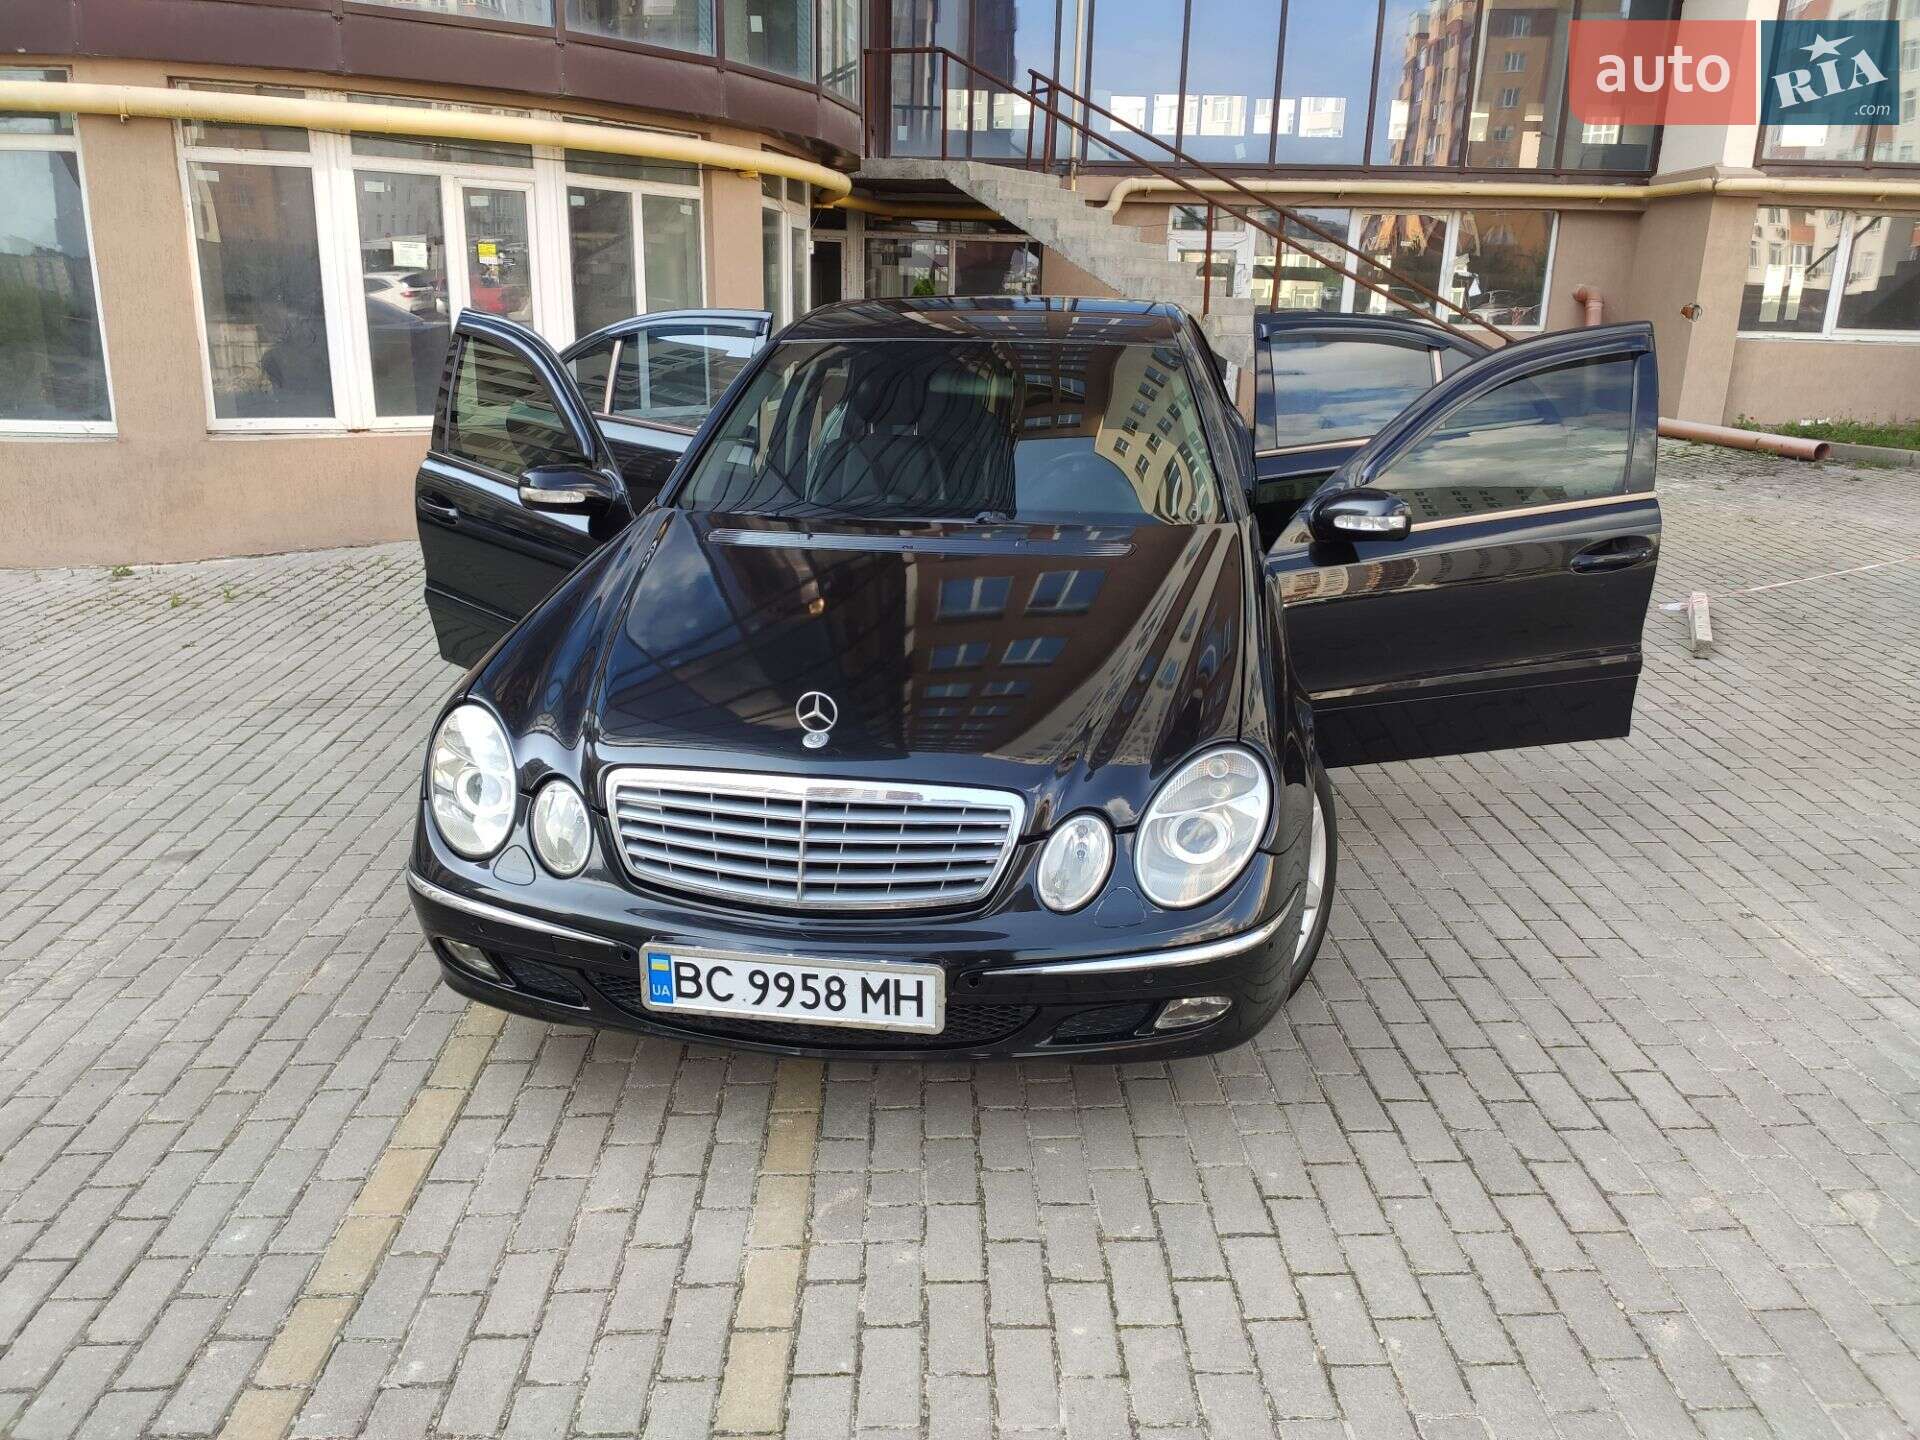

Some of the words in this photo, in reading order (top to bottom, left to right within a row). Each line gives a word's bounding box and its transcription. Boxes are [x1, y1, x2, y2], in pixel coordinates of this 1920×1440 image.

[652, 984, 671, 996] UA
[674, 961, 734, 1002] BC
[748, 969, 847, 1012] 9958
[860, 976, 923, 1018] MH
